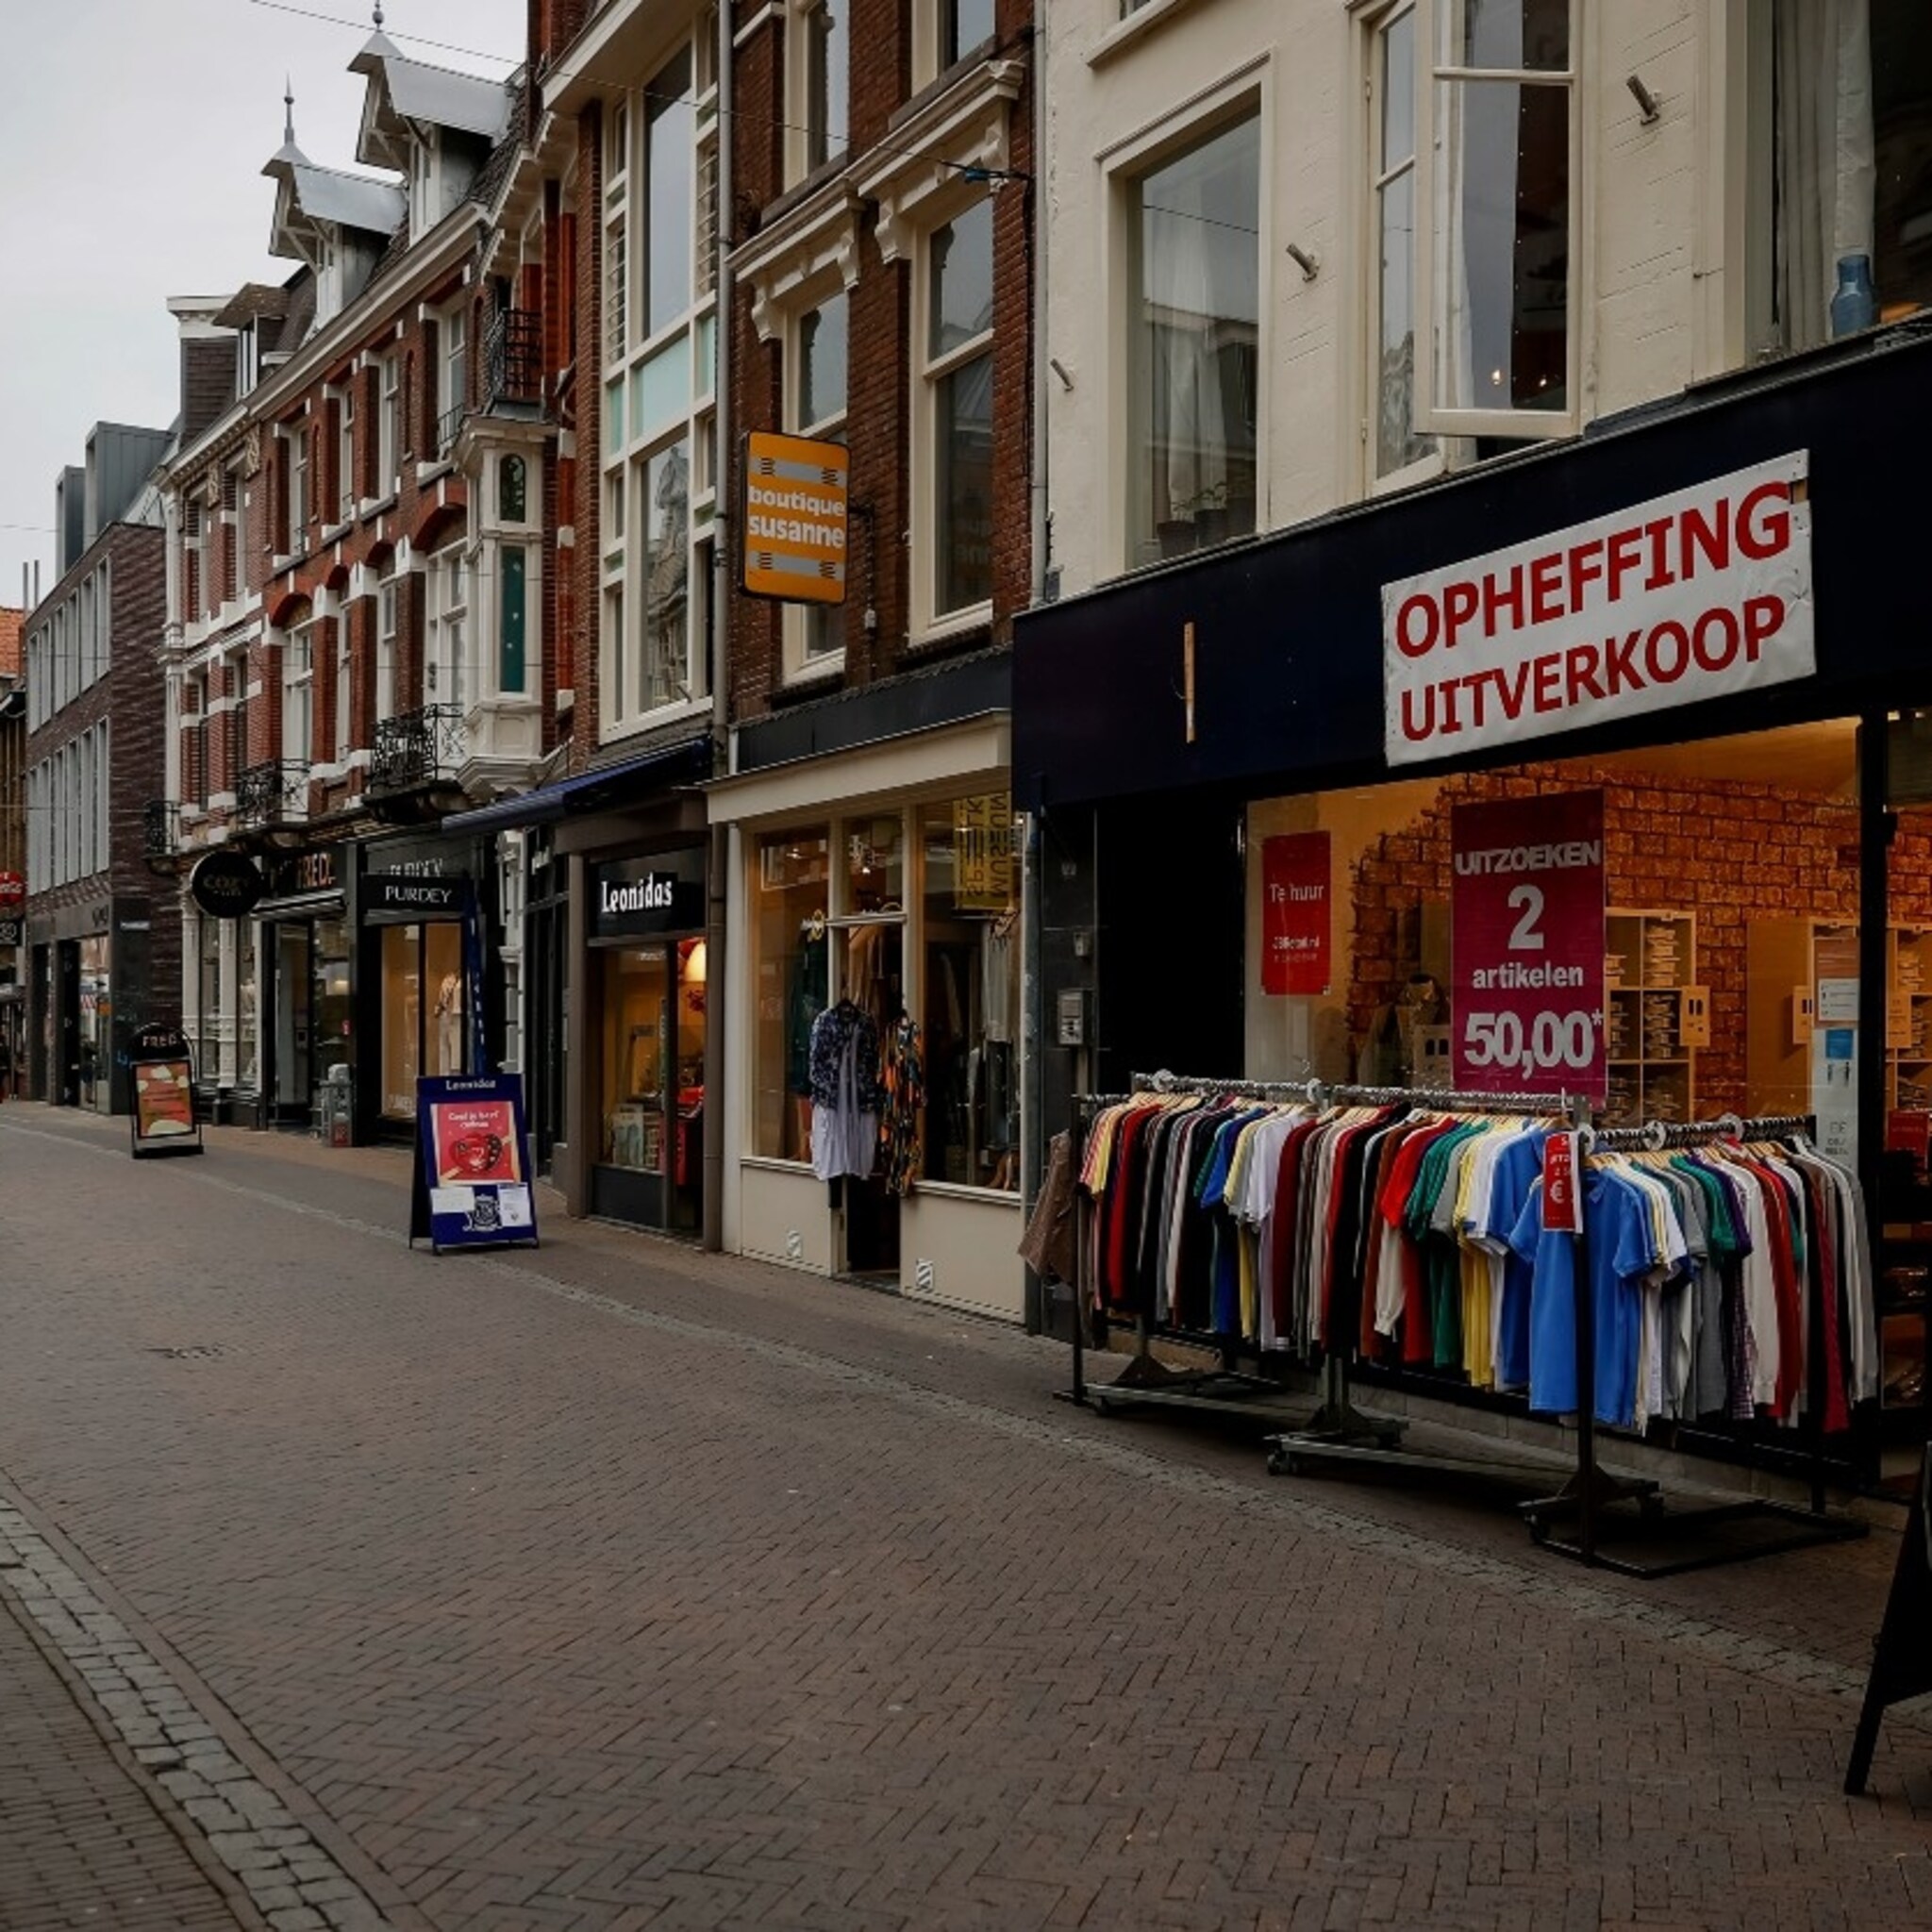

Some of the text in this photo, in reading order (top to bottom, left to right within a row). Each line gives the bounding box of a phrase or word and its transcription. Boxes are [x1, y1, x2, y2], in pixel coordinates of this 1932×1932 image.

[748, 486, 845, 516] boutique
[748, 515, 845, 548] susanne
[1396, 480, 1791, 658] OPHEFFING
[1400, 594, 1786, 741] UITVERKOOP
[1455, 839, 1602, 876] UITZOEKEN
[385, 885, 452, 904] PURDEY
[601, 872, 673, 913] Leonidas
[1269, 883, 1324, 903] Te huur
[1507, 883, 1545, 951] 2
[1472, 958, 1585, 990] artikelen
